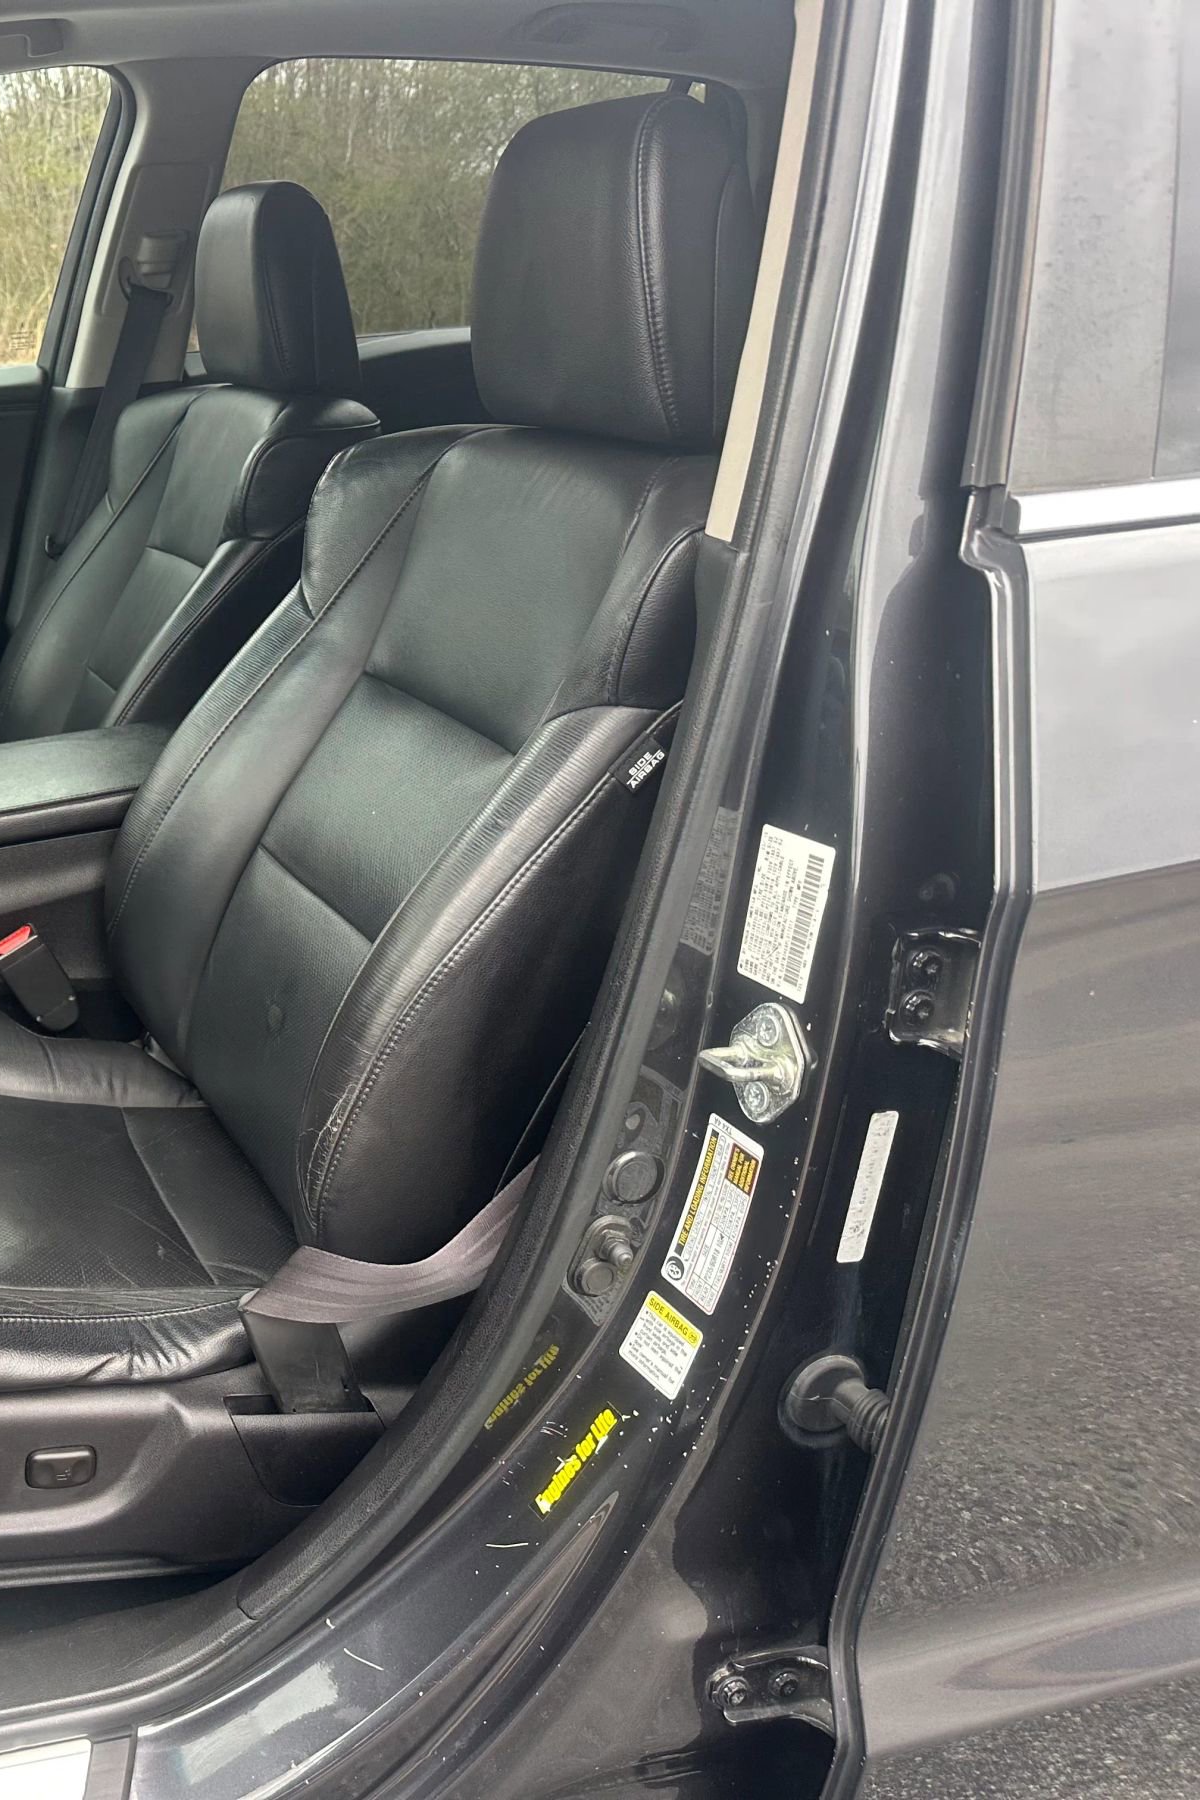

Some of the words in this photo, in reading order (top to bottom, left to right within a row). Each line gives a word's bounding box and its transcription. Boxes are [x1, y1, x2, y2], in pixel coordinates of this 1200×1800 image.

[628, 751, 652, 776] SIDE
[630, 750, 665, 788] AIRBAG
[697, 1134, 719, 1185] INFORMATION
[688, 1182, 704, 1216] LOADING
[678, 1227, 689, 1247] TIRE
[683, 1213, 694, 1232] AND
[648, 1296, 665, 1315] SIDE
[664, 1311, 689, 1336] AIRBAG
[575, 1433, 597, 1462] for
[589, 1409, 617, 1441] Life
